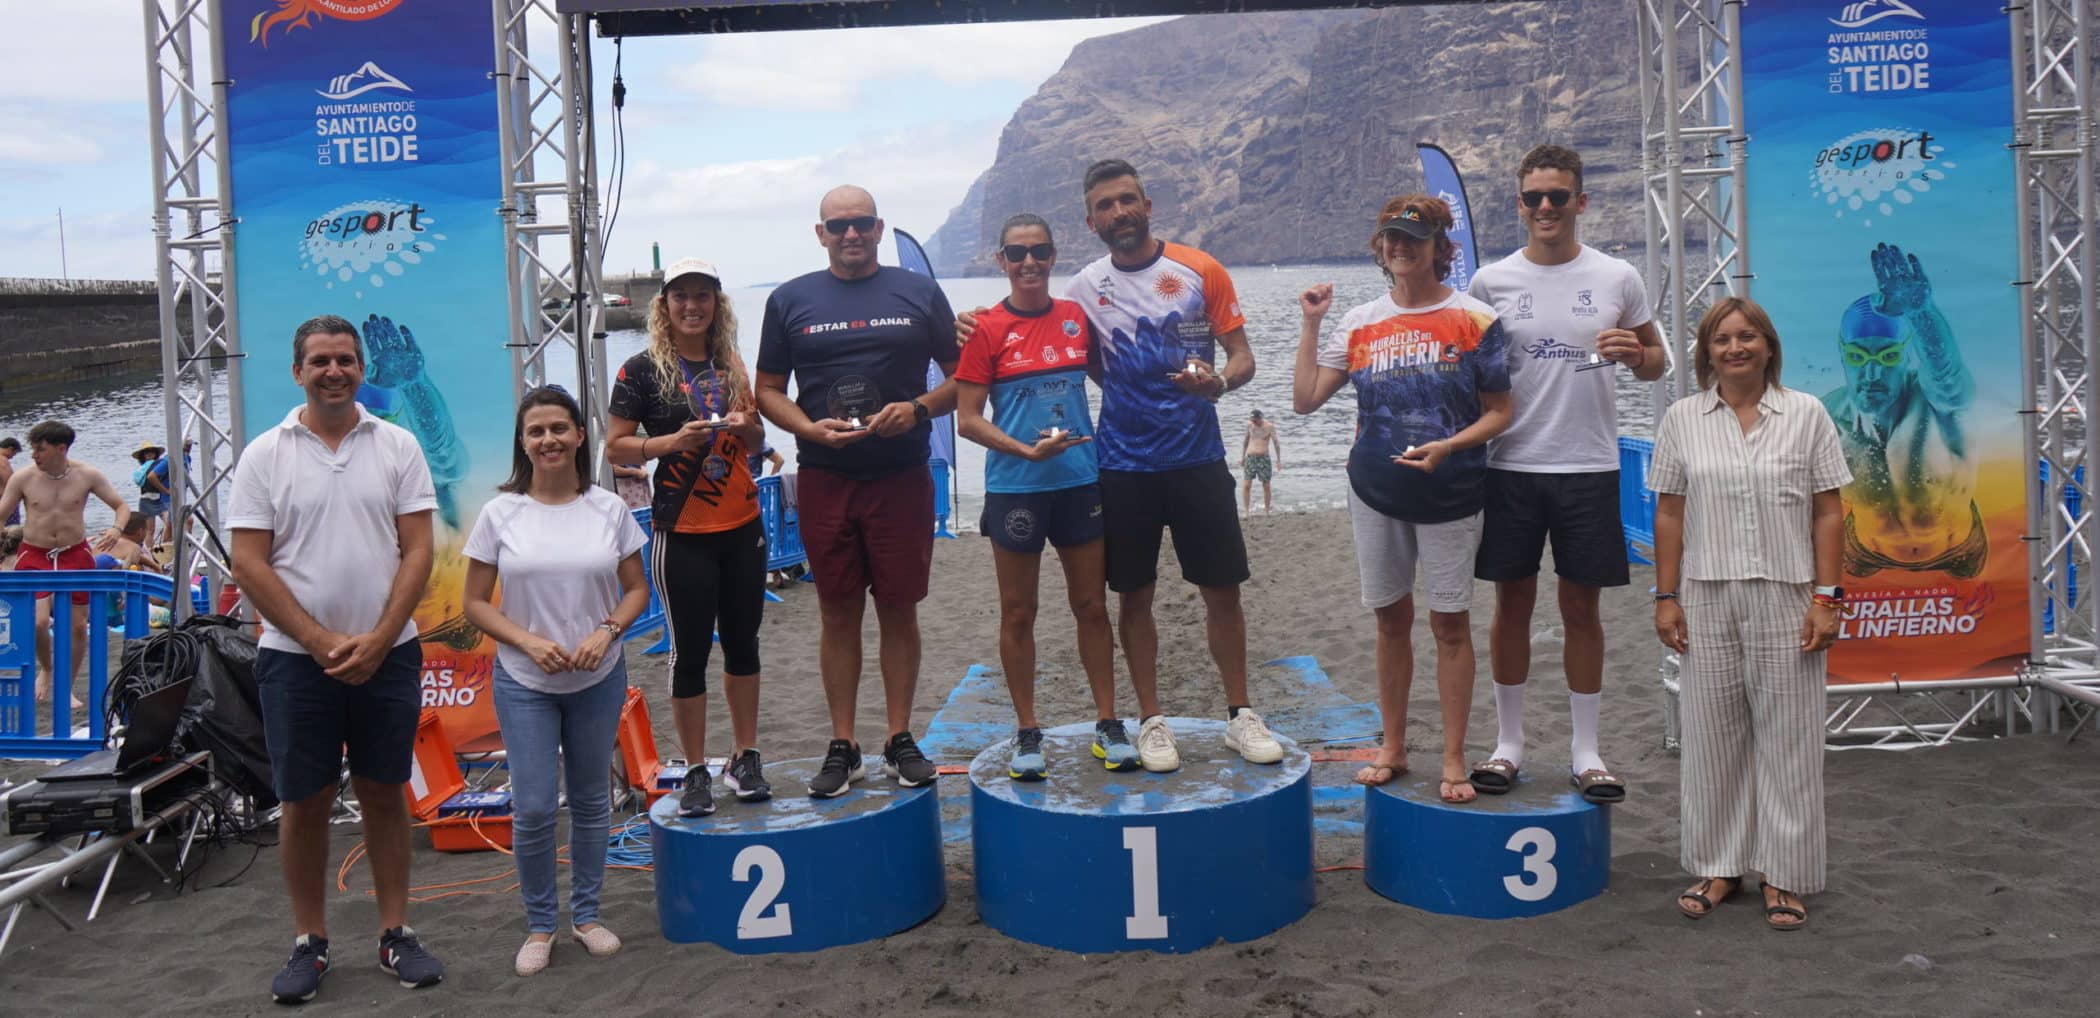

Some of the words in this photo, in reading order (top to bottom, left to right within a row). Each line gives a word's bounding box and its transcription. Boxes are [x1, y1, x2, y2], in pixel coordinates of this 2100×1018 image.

[1828, 42, 1929, 64] SANTIAGO
[1829, 68, 1842, 94] DEL
[1844, 63, 1930, 92] TEIDE
[316, 114, 417, 136] SANTIAGO
[318, 138, 331, 165] DEL
[333, 135, 418, 164] TEIDE
[1815, 131, 1934, 168] gesport
[305, 203, 425, 240] gesport
[870, 317, 911, 327] GANAR
[1370, 329, 1420, 352] MURALLAS
[1534, 348, 1586, 359] Anthus
[1841, 596, 1953, 620] URALLAS
[1857, 614, 1976, 638] INFIERNO
[421, 669, 453, 688] AS
[1503, 826, 1558, 901] 3
[732, 845, 792, 939] 2
[1122, 826, 1168, 939] 1
